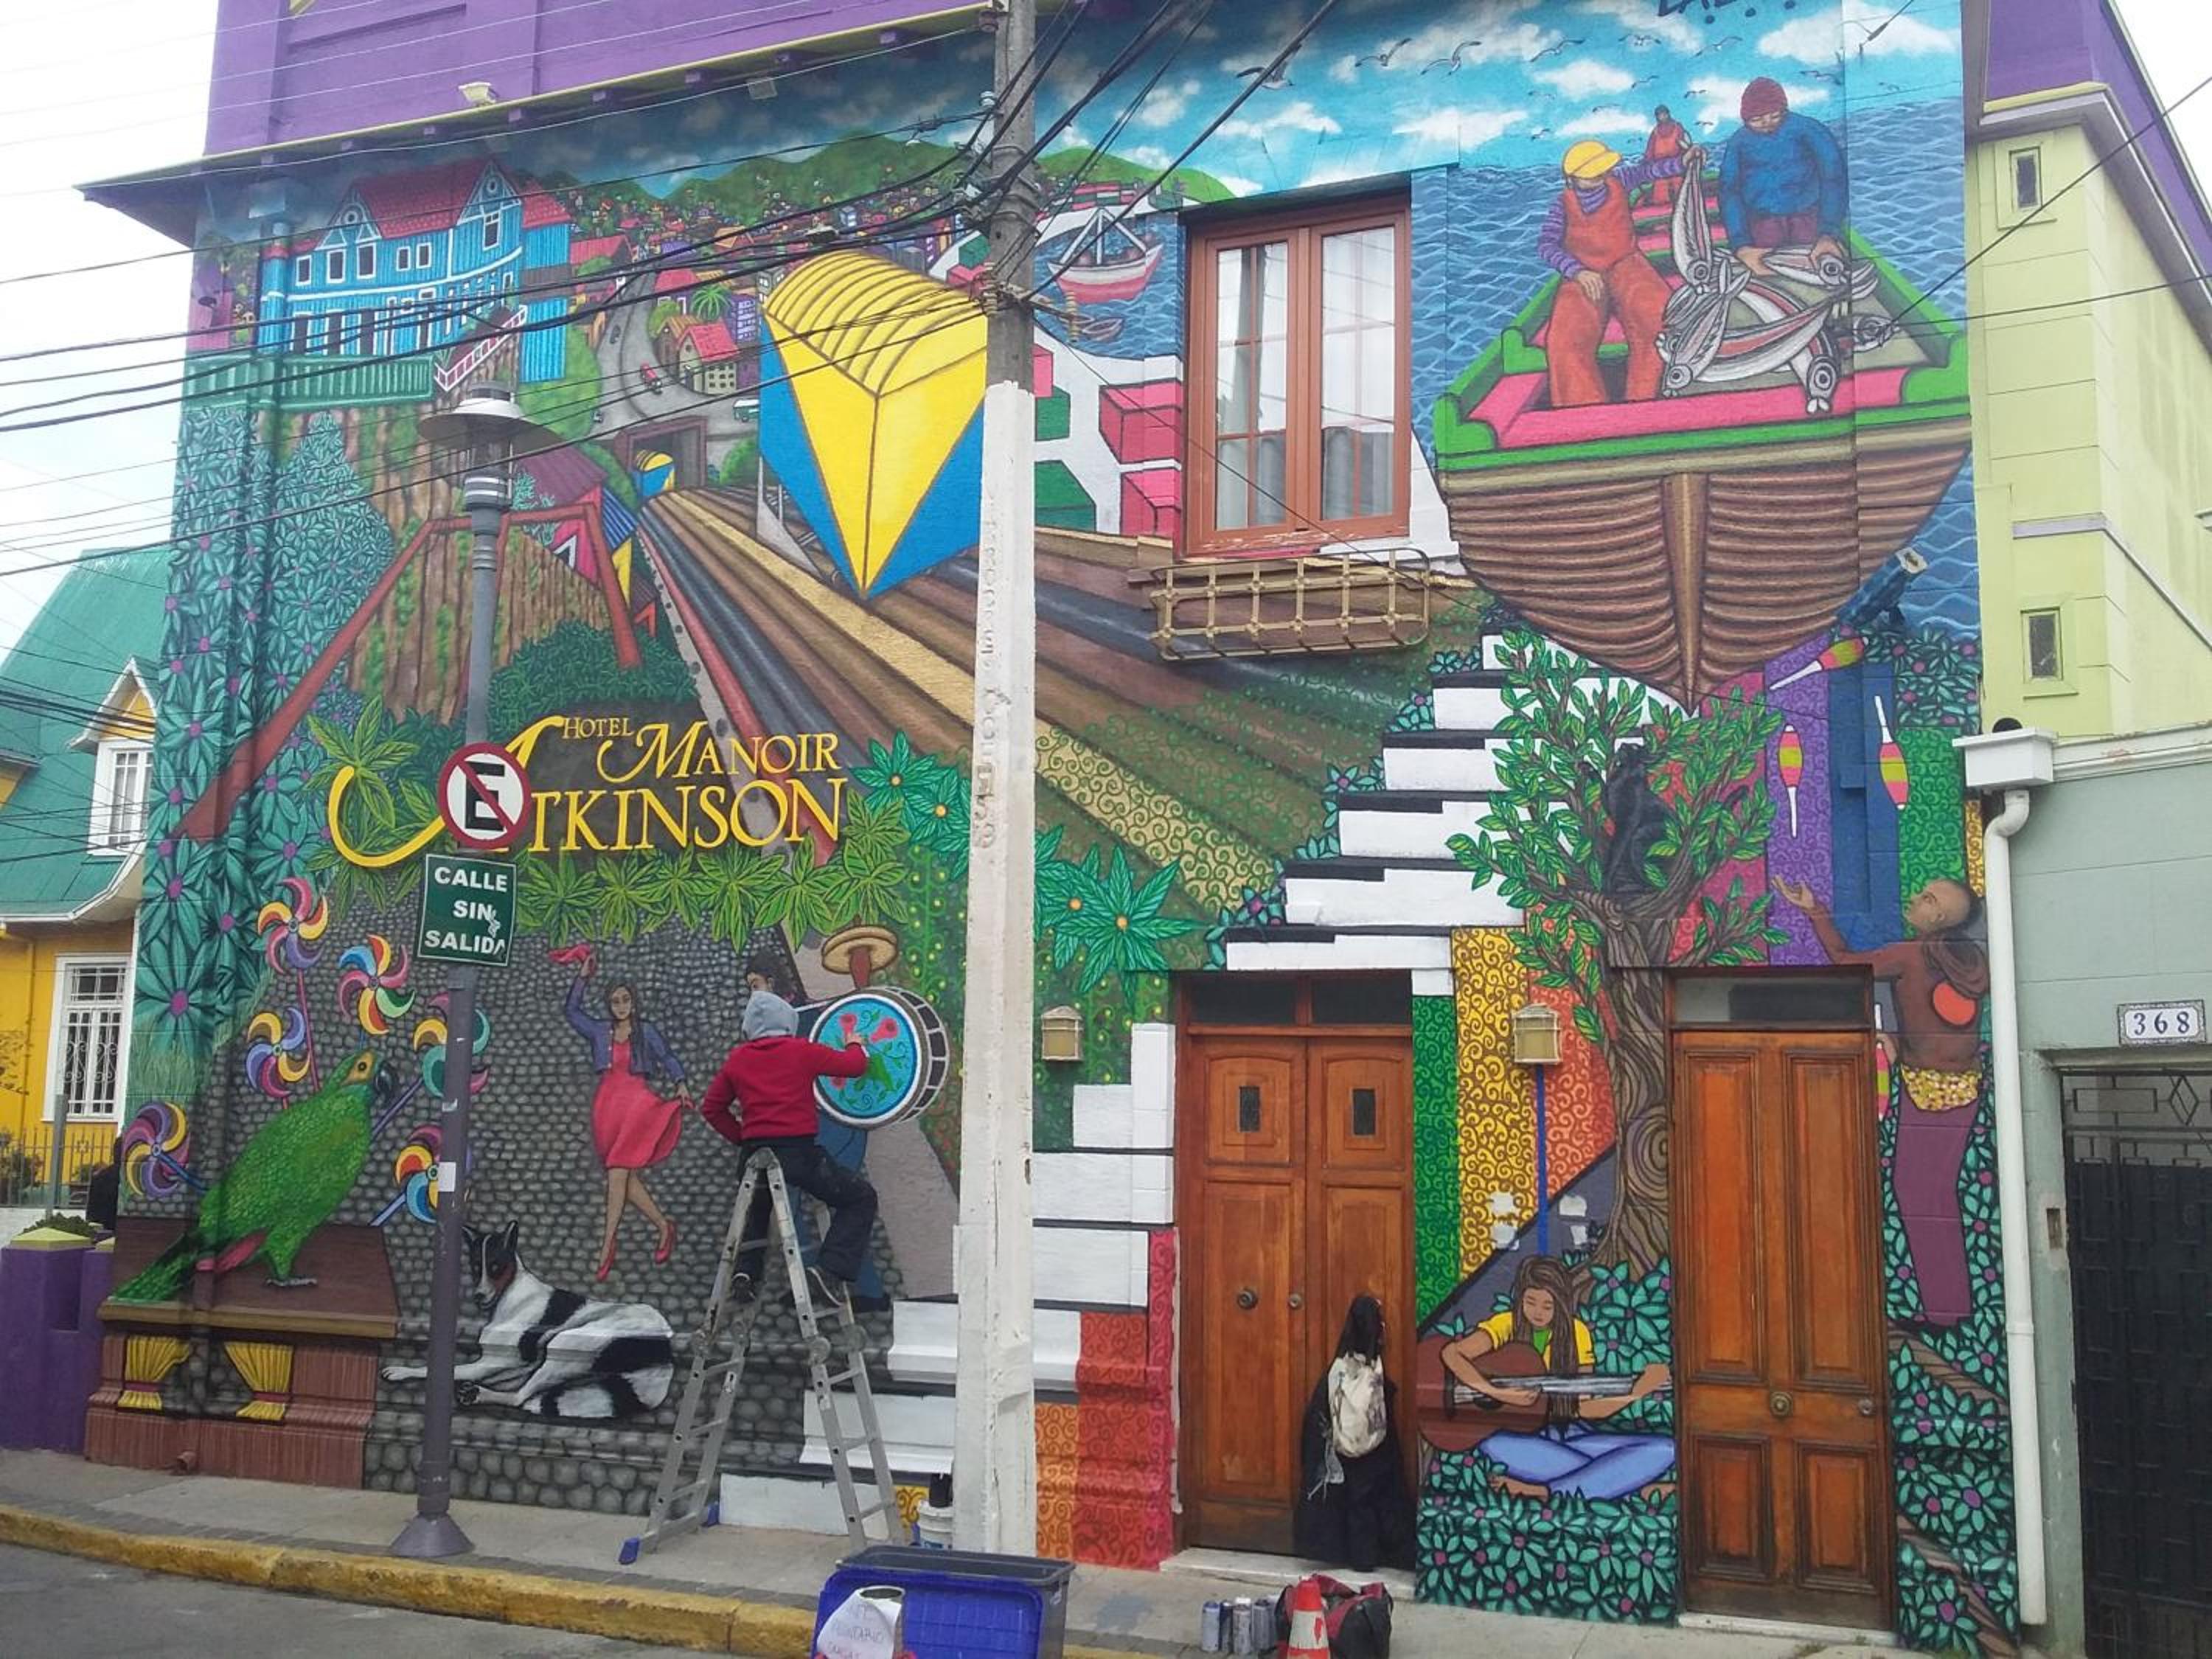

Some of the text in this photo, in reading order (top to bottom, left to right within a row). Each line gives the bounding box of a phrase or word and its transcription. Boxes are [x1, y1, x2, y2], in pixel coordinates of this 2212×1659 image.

[562, 717, 635, 739] HOTEL
[597, 720, 842, 783] MANOIR
[434, 866, 507, 893] CALLE
[453, 900, 493, 920] SIN
[424, 930, 506, 956] SALIDA
[2133, 1011, 2191, 1035] 368
